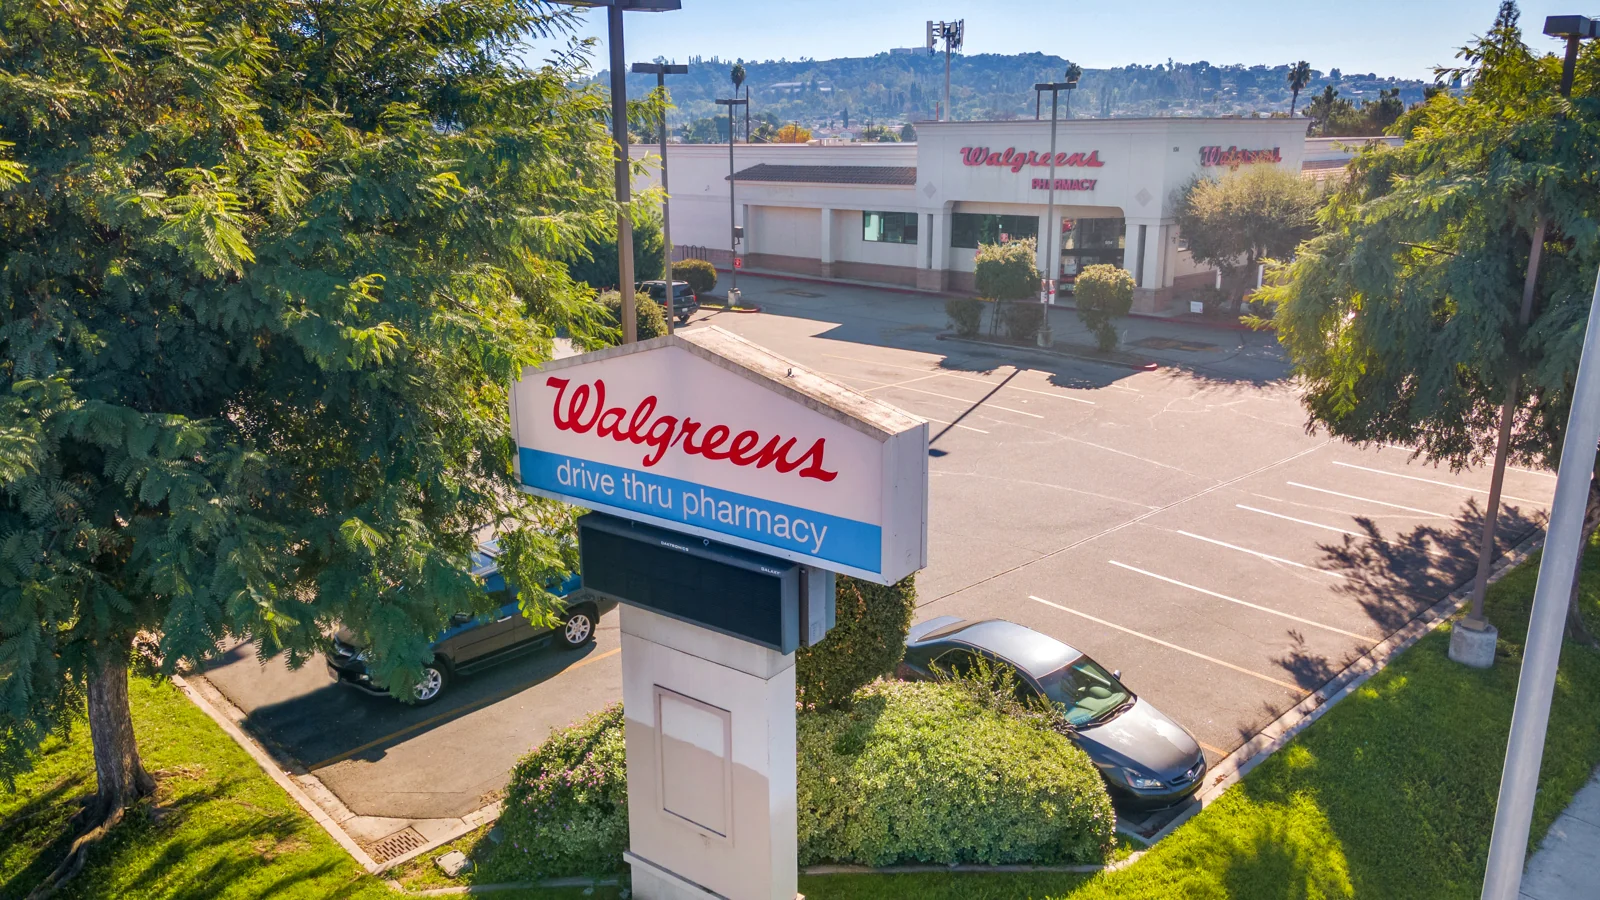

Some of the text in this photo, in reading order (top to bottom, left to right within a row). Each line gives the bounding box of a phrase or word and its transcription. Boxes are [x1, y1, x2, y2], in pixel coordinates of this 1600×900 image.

[959, 146, 1105, 173] Walgreens
[546, 376, 839, 482] Walgreens
[556, 459, 828, 554] drive thru pharmacy
